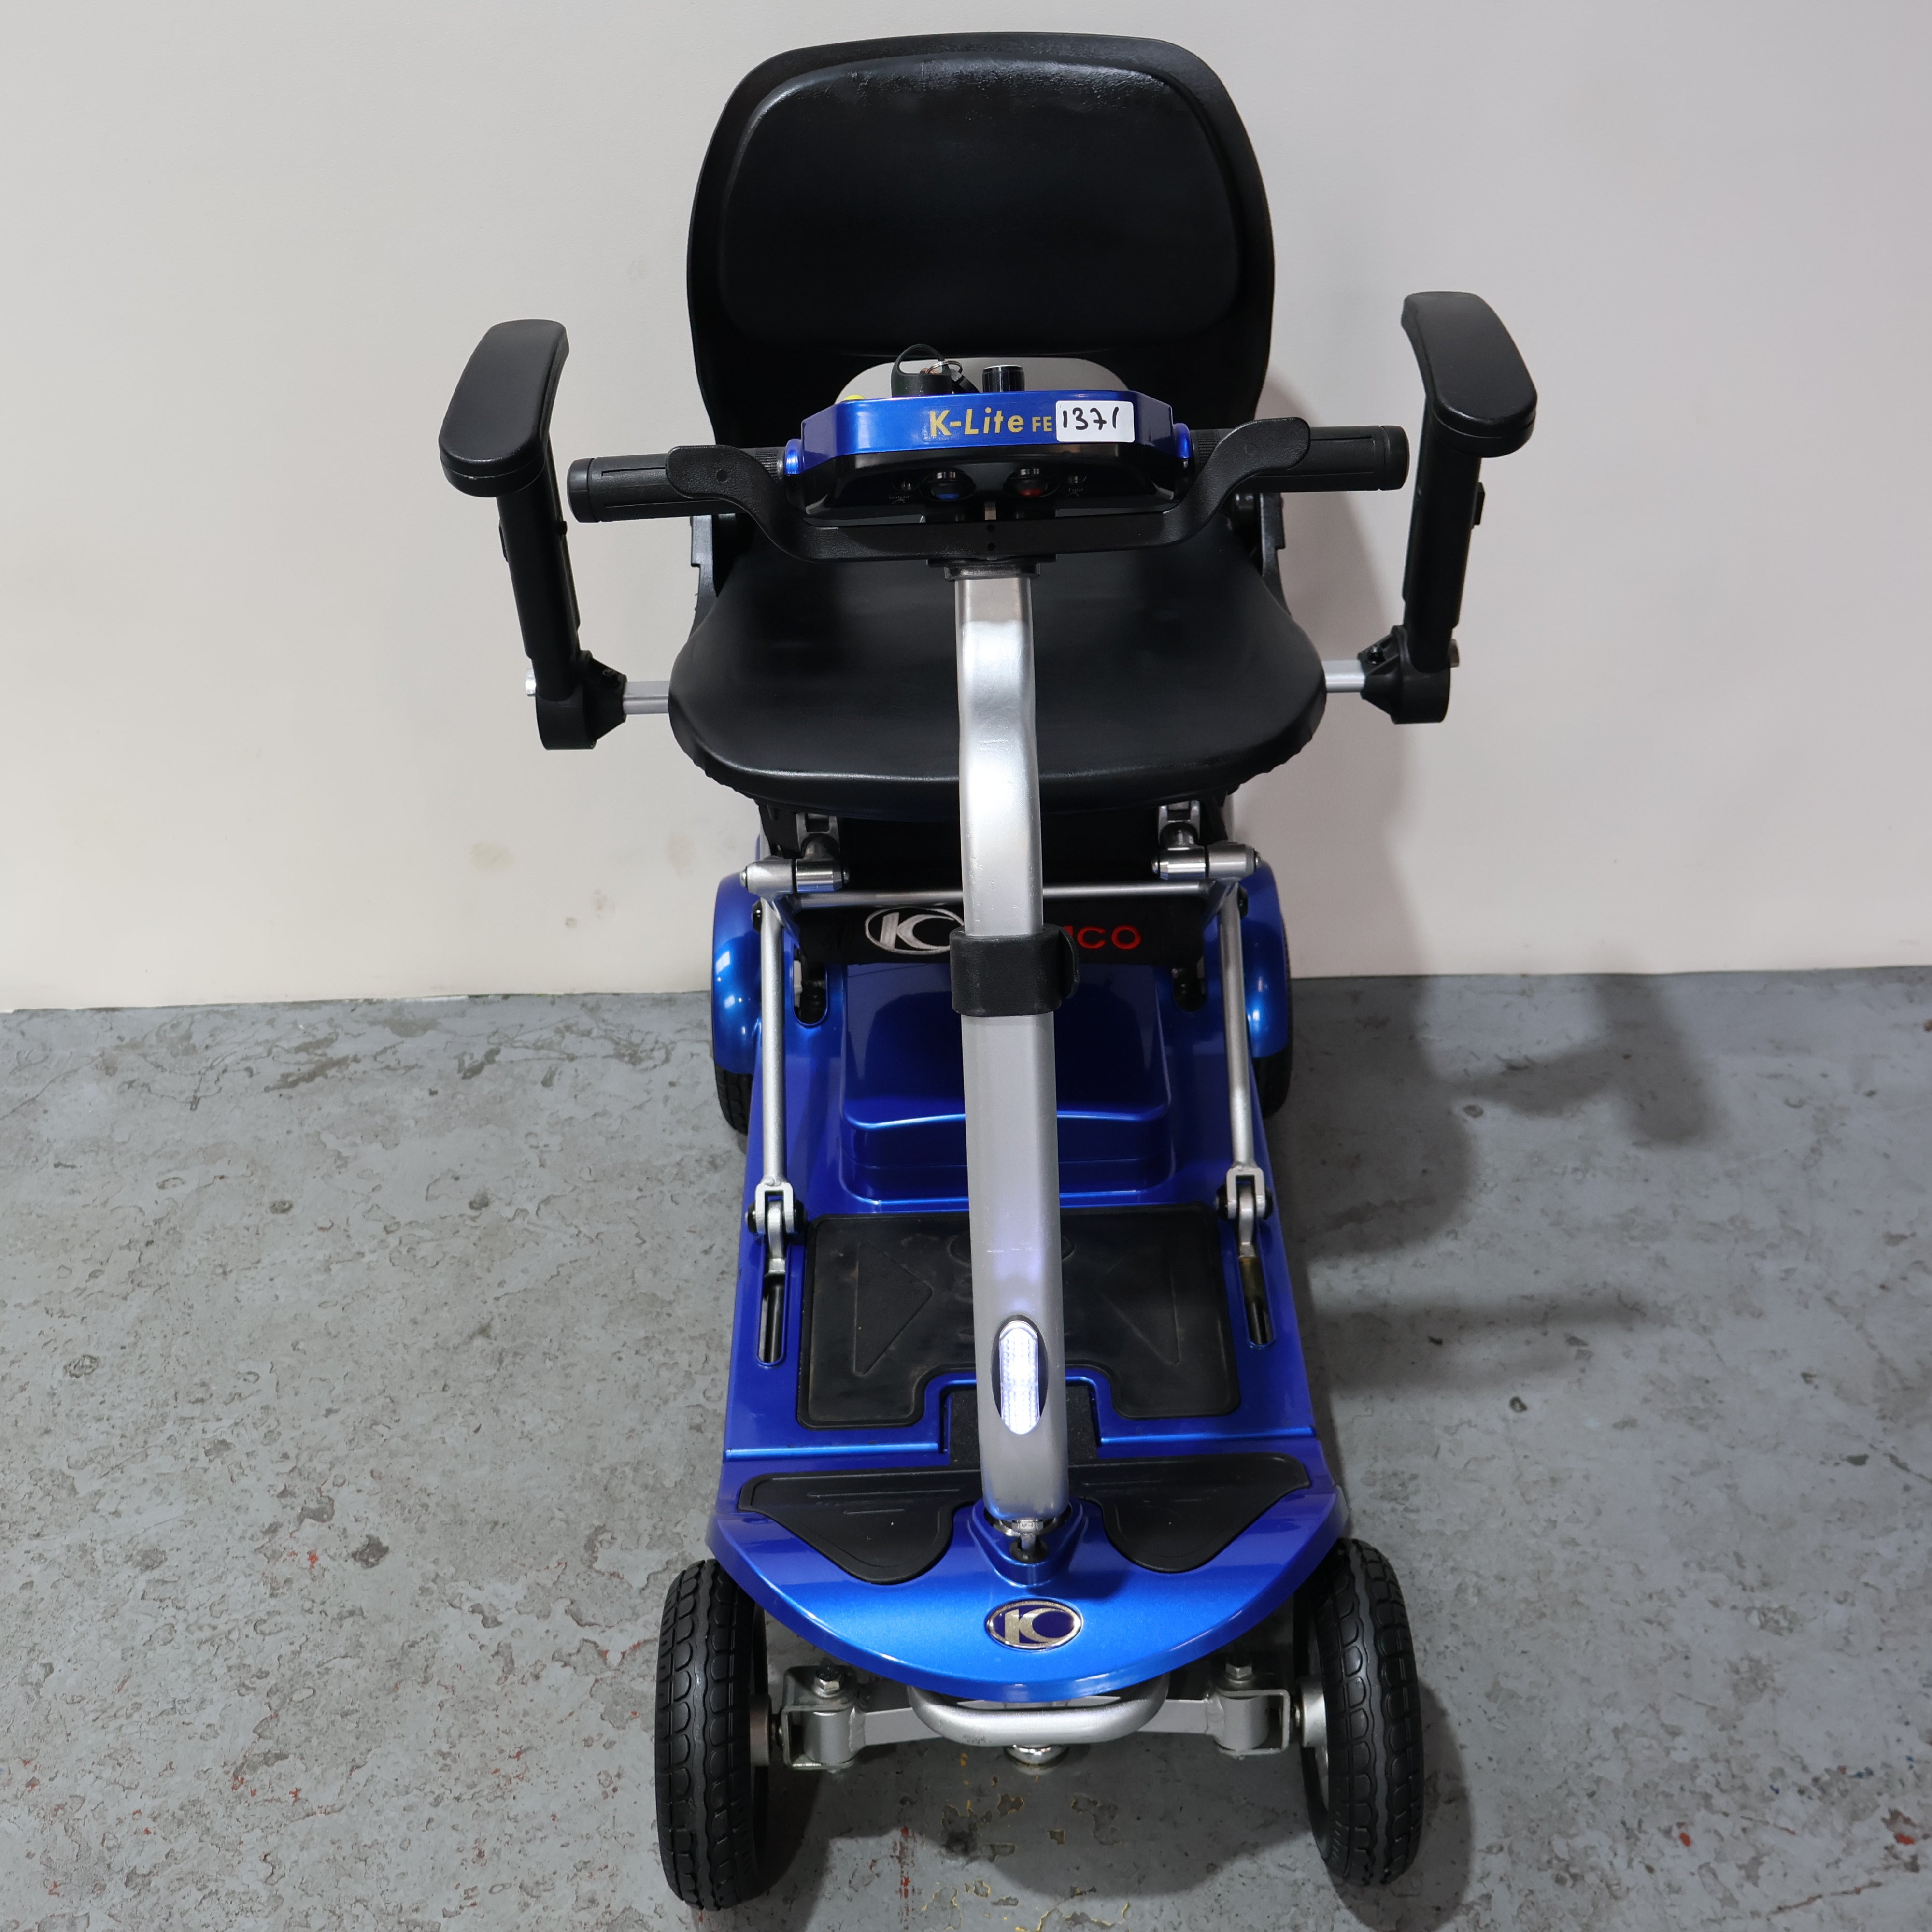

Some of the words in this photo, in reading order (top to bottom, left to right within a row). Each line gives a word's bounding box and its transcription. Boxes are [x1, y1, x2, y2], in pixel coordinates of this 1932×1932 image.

[929, 406, 1024, 438] K-Lite
[1032, 416, 1053, 432] FE
[1063, 406, 1120, 430] 1371
